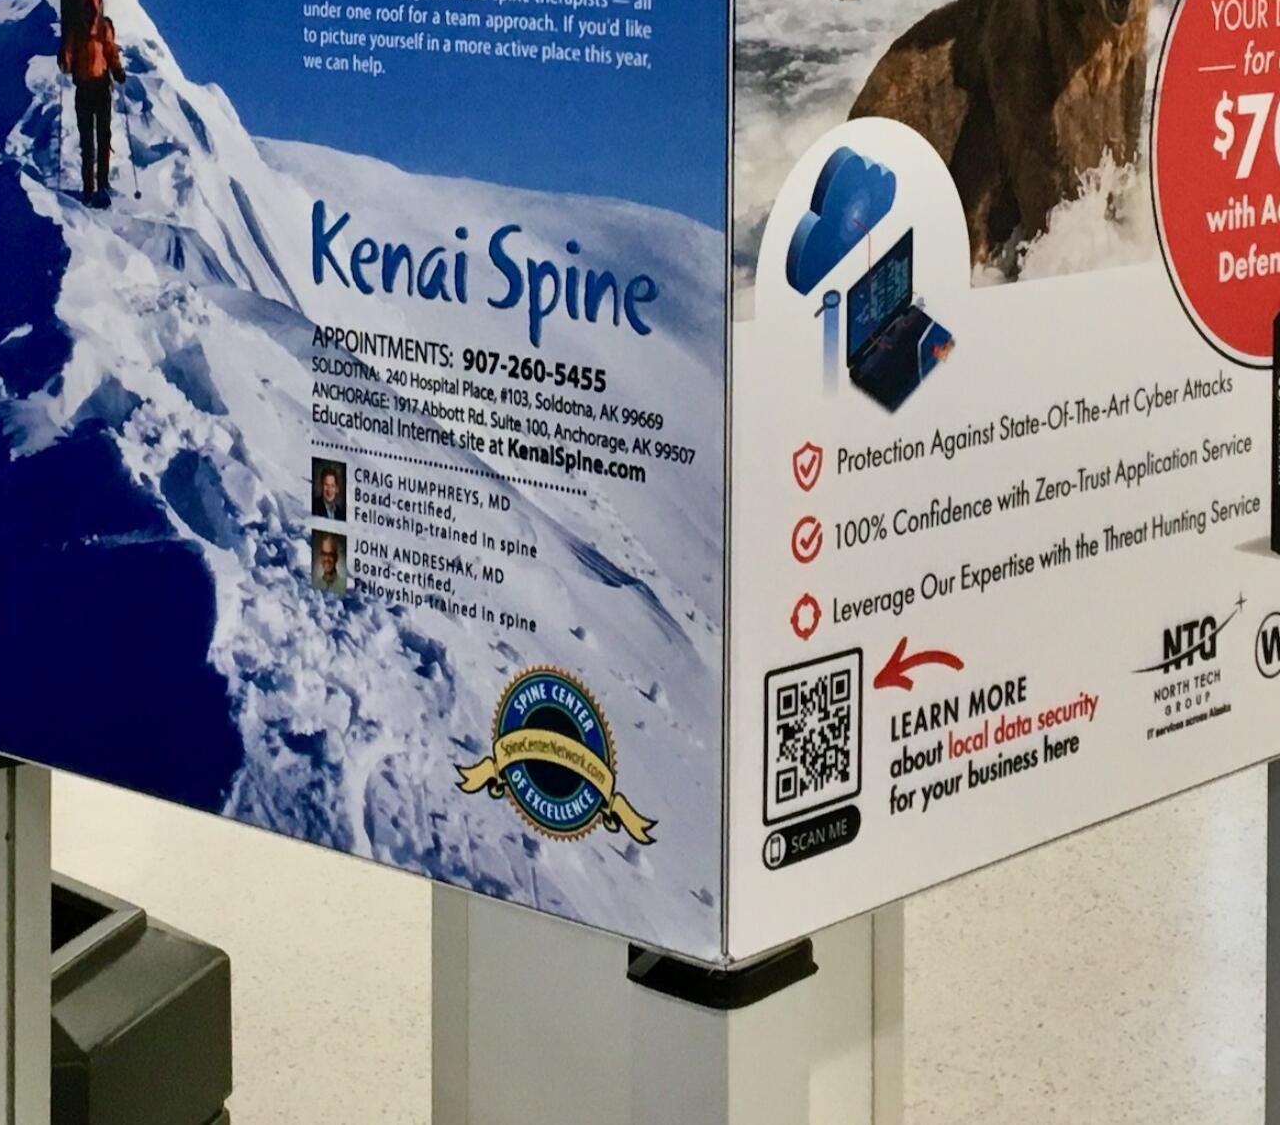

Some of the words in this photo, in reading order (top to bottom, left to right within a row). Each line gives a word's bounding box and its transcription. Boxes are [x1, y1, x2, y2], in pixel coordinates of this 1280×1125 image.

[1245, 41, 1275, 75] for
[1207, 199, 1255, 232] with
[312, 200, 468, 304] Kenai
[488, 225, 659, 347] Spine
[312, 325, 453, 368] APPOINTMENTS:
[463, 349, 606, 393] 907-260-5455
[312, 356, 380, 382] SOLDOTNA:
[386, 369, 407, 386] 240
[411, 372, 459, 395] Hospital
[463, 381, 497, 403] Place,
[501, 388, 531, 409] #103,
[536, 392, 596, 421] Soldotna,
[600, 404, 618, 423] AK
[622, 408, 663, 430] 99669
[312, 382, 389, 409] ANCHORAGE:
[394, 395, 418, 413] 1917
[422, 399, 465, 422] Abbott
[468, 408, 487, 426] Rd.
[491, 411, 522, 432] Suite
[526, 418, 551, 439] 100,
[554, 423, 628, 454] Anchorage,
[632, 438, 651, 456] AK
[655, 442, 695, 464] 99507
[313, 405, 393, 435] Educational
[398, 419, 456, 449] Internet
[459, 431, 485, 453] site
[489, 438, 504, 456] at
[508, 438, 646, 483] KenaiSpine.com
[838, 438, 924, 474] Protection
[931, 422, 994, 455] Against
[1000, 394, 1130, 440] State-Of-The-Art
[1134, 385, 1178, 416] Cyber
[1183, 373, 1232, 401] Attacks
[355, 468, 392, 488] CRAIG
[399, 477, 482, 508] HUMPHREYS,
[489, 494, 510, 511] MD
[355, 487, 455, 522] Board-certified,
[836, 514, 888, 550] 100%
[893, 496, 992, 535] Confidence
[997, 480, 1030, 511] with
[1035, 466, 1111, 502] Zero-Trust
[1116, 449, 1198, 488] Application
[1202, 435, 1251, 463] Service
[354, 539, 389, 560] JOHN
[483, 566, 503, 584] MD
[834, 588, 914, 623] Leverage
[921, 573, 955, 599] Our
[961, 554, 1034, 592] Expertise
[1039, 538, 1071, 568] with
[1076, 534, 1098, 559] the
[1103, 523, 1147, 551] Threat
[1153, 510, 1206, 539] Hunting
[1211, 497, 1260, 523] Service
[1163, 616, 1217, 674] NTG
[513, 683, 547, 715] SPINE
[551, 684, 594, 732] CENTER
[892, 697, 958, 742] LEARN
[969, 676, 1026, 717] MORE
[1154, 680, 1189, 702] NORTH
[1194, 670, 1220, 688] TECH
[1165, 691, 1210, 716] GROUP
[501, 736, 606, 785] SpineCenterNetwork.com
[890, 741, 943, 778] about
[949, 720, 988, 759] local
[994, 716, 1031, 755] data
[1038, 695, 1098, 745] security
[511, 770, 527, 789] OF
[525, 789, 594, 821] EXCELLENCE
[890, 785, 916, 814] for
[922, 775, 962, 809] your
[968, 749, 1038, 788] business
[1044, 736, 1079, 762] here
[792, 828, 825, 853] SCAN
[829, 819, 847, 838] ME
